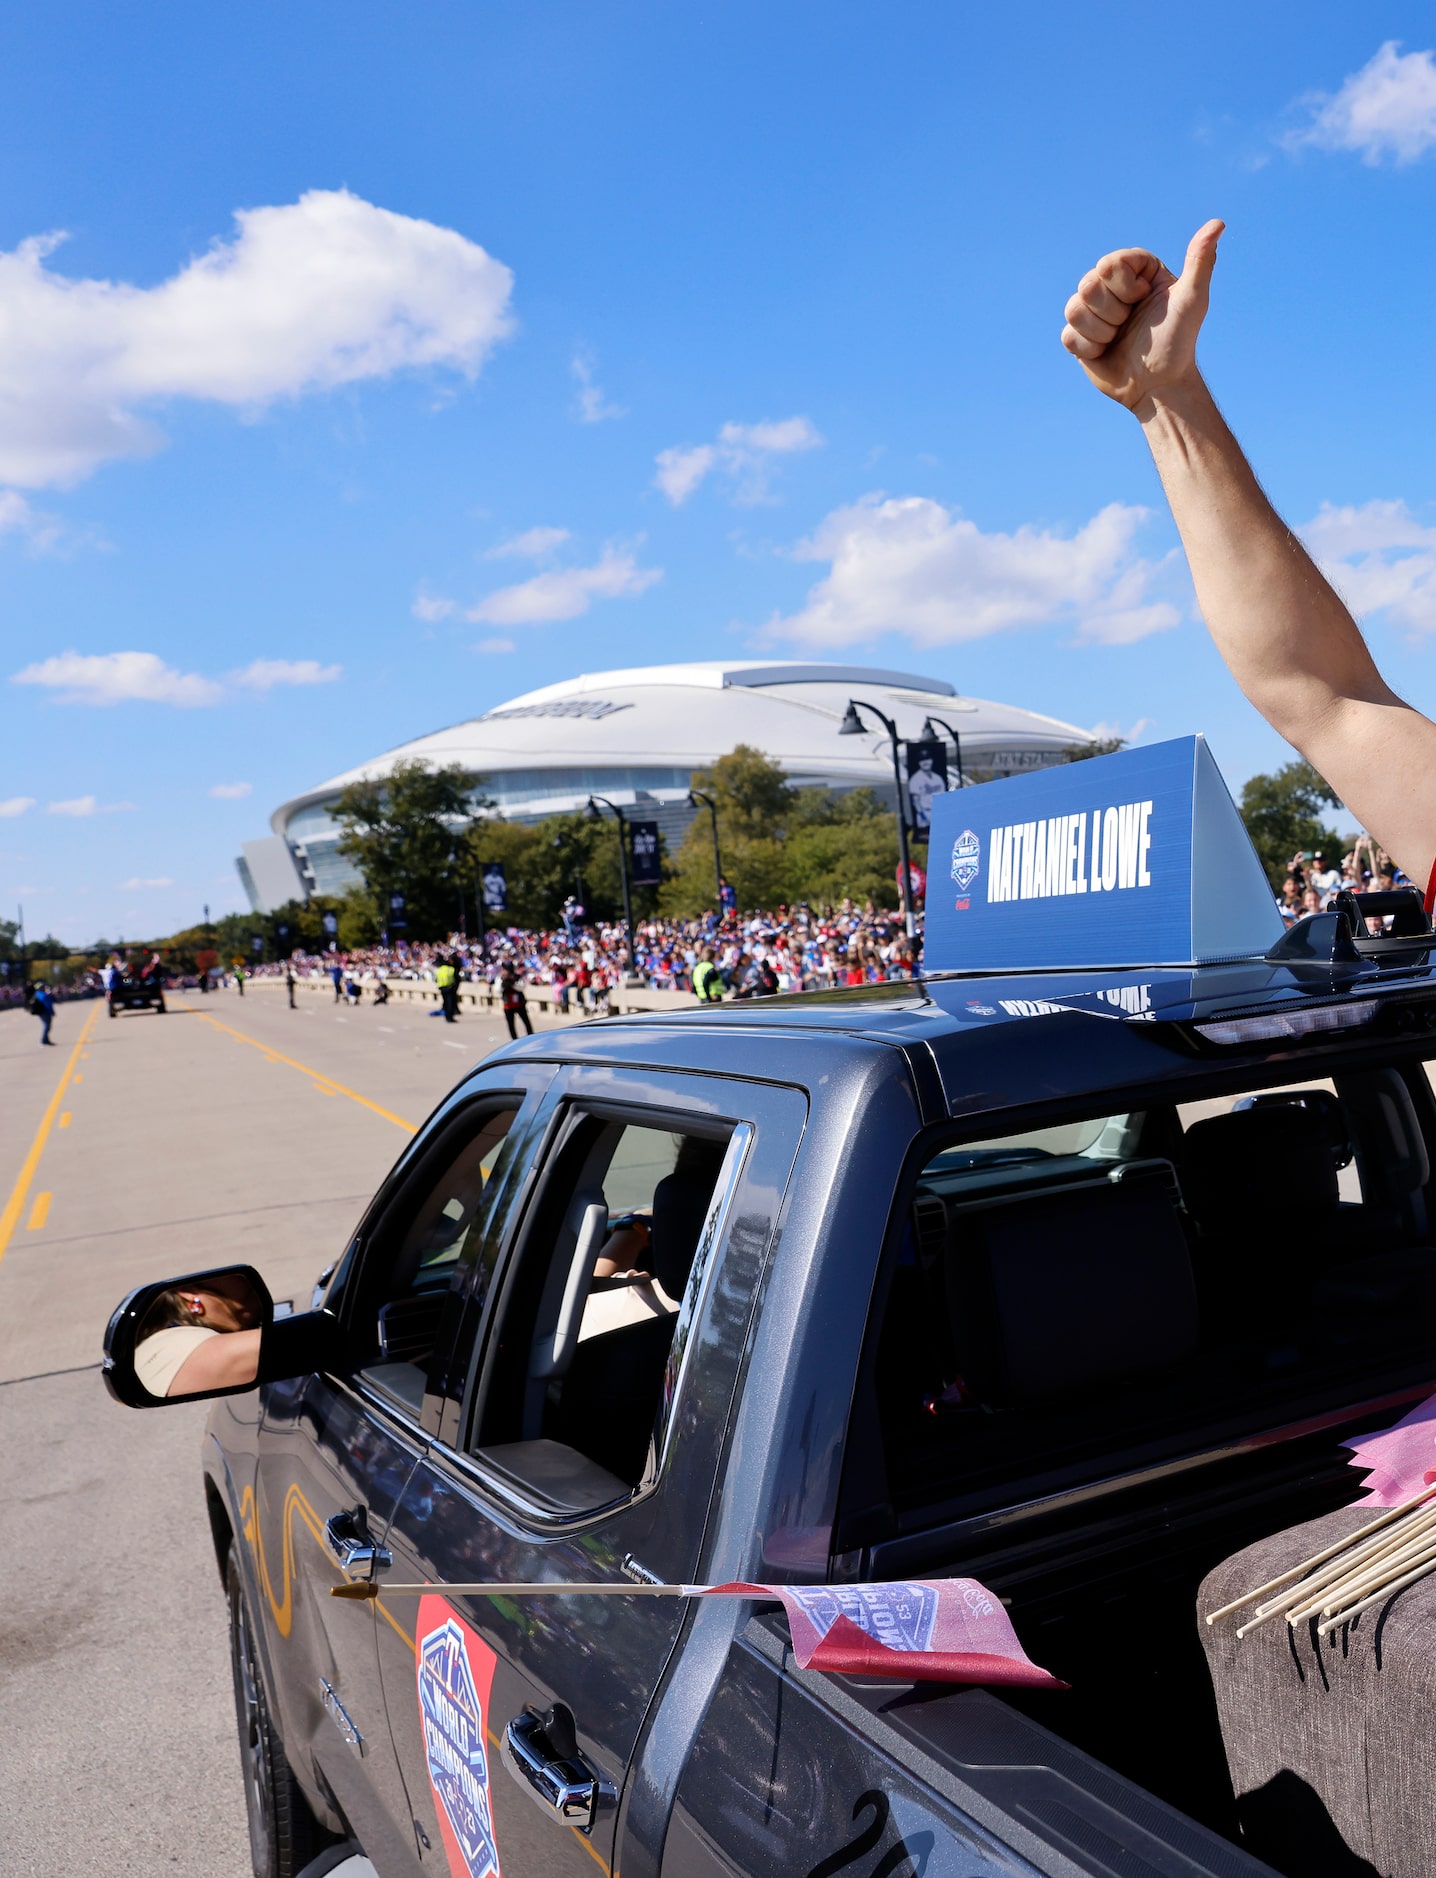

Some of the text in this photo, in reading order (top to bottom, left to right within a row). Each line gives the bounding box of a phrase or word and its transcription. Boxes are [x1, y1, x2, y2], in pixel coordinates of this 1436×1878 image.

[987, 800, 1153, 903] NATHANIEL LOWE
[432, 1682, 470, 1759] WORLD
[425, 1715, 490, 1833] CHAMPIONS
